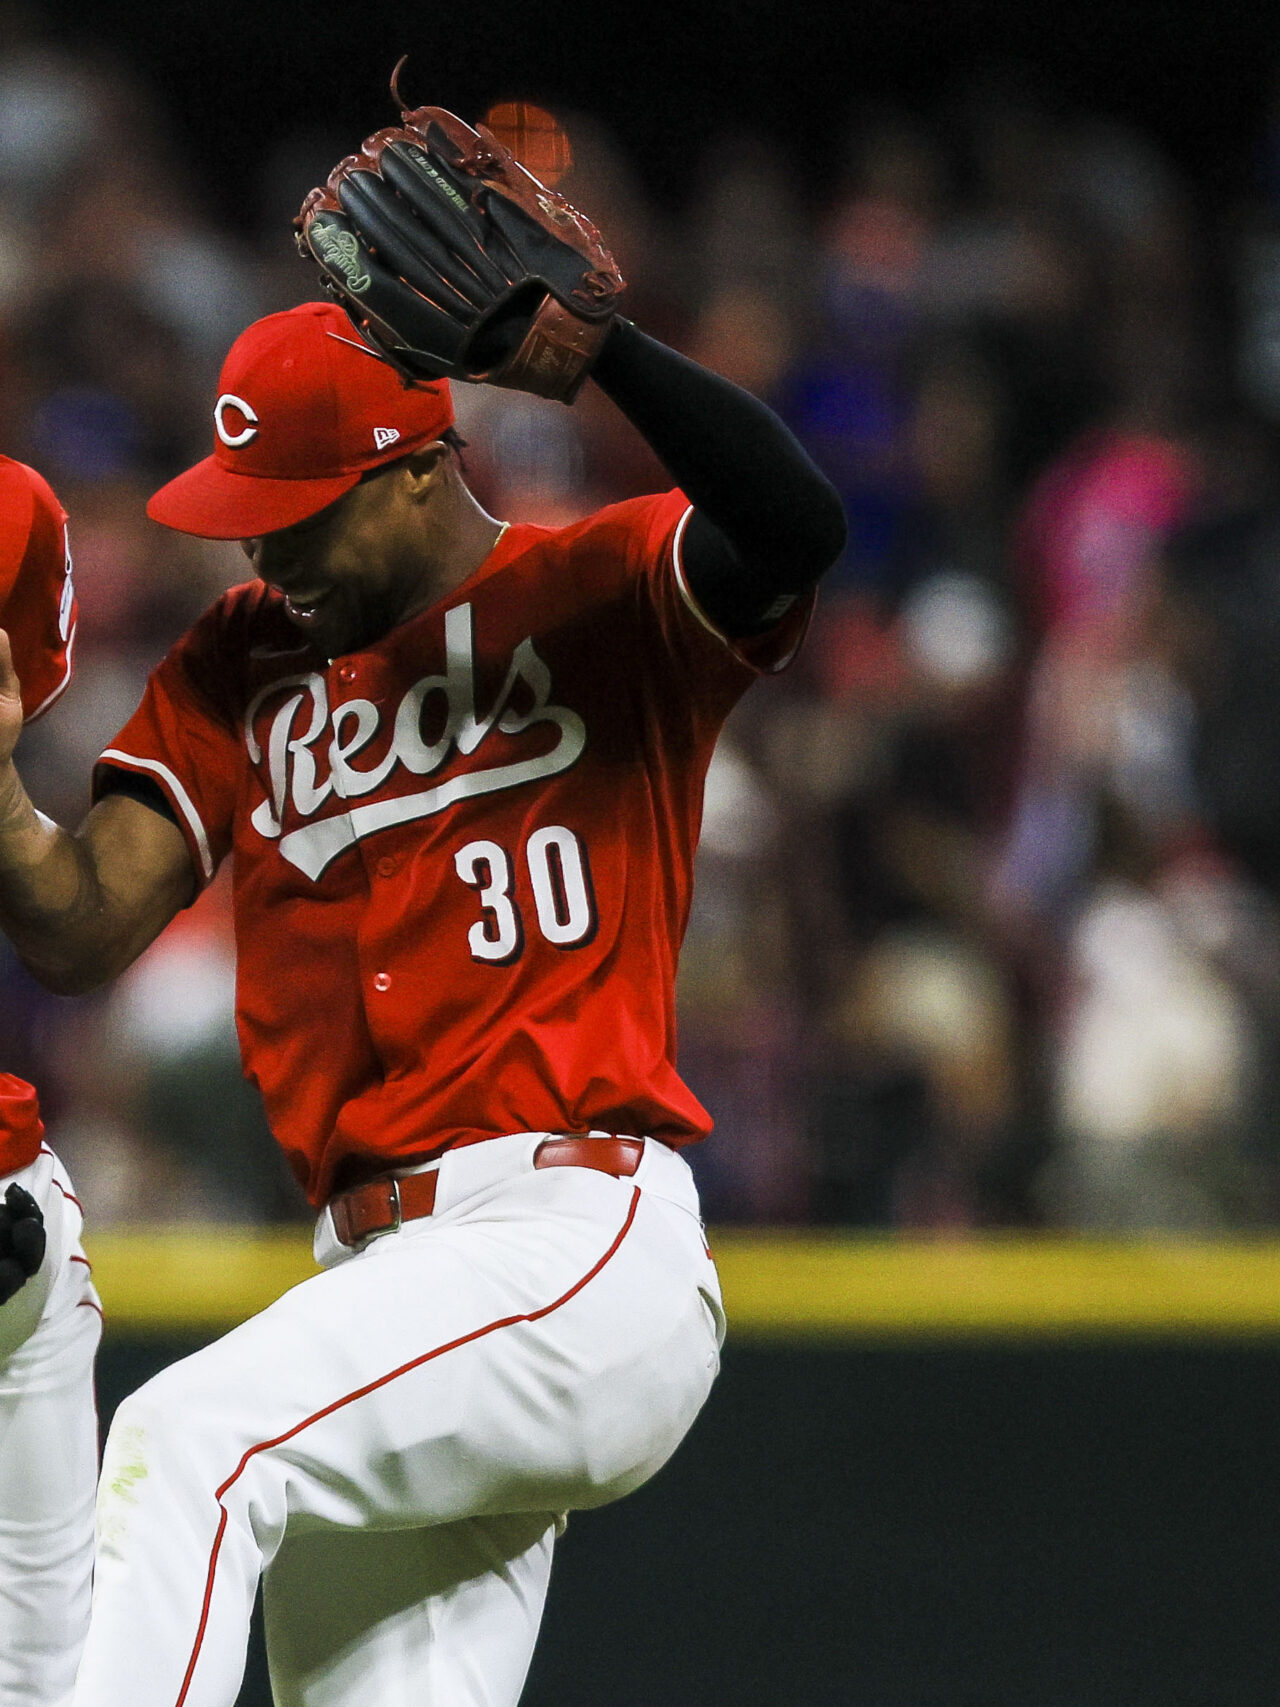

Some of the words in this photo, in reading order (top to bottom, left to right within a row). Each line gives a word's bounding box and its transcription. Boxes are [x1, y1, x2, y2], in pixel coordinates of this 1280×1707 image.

[310, 222, 372, 294] Rawlings
[214, 393, 260, 448] C
[245, 601, 586, 882] Reds
[454, 825, 598, 967] 30
